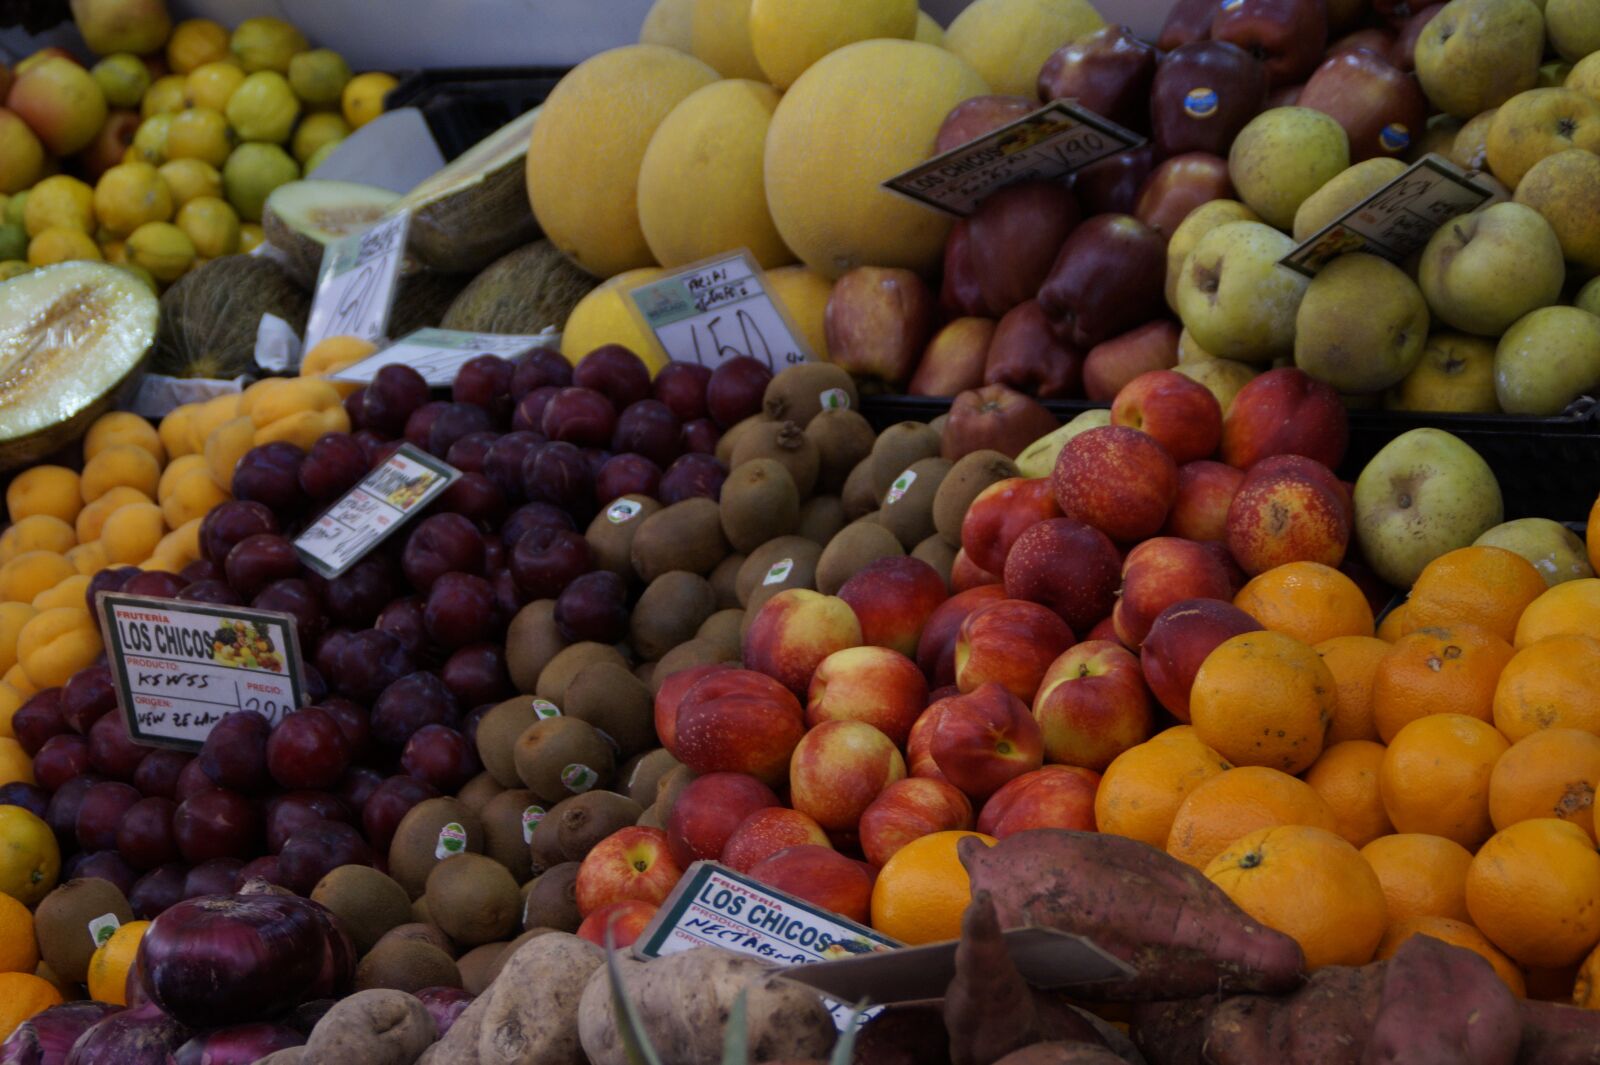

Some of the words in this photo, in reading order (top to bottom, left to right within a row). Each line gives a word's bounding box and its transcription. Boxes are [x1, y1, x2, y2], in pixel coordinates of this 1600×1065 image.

[116, 610, 170, 623] FRUTERÍA
[119, 620, 152, 651] LOS
[154, 624, 215, 660] CHICOS
[126, 657, 179, 671] PRODUCTO:
[246, 682, 284, 695] PRECIO:
[134, 695, 173, 708] ORIGEN:
[137, 711, 165, 728] NEW
[711, 876, 783, 912] FRUTERÍA
[690, 905, 764, 942] PRODUCTO:
[700, 883, 747, 916] LOS
[747, 904, 832, 953] CHICOS
[674, 930, 707, 946] ORIG
